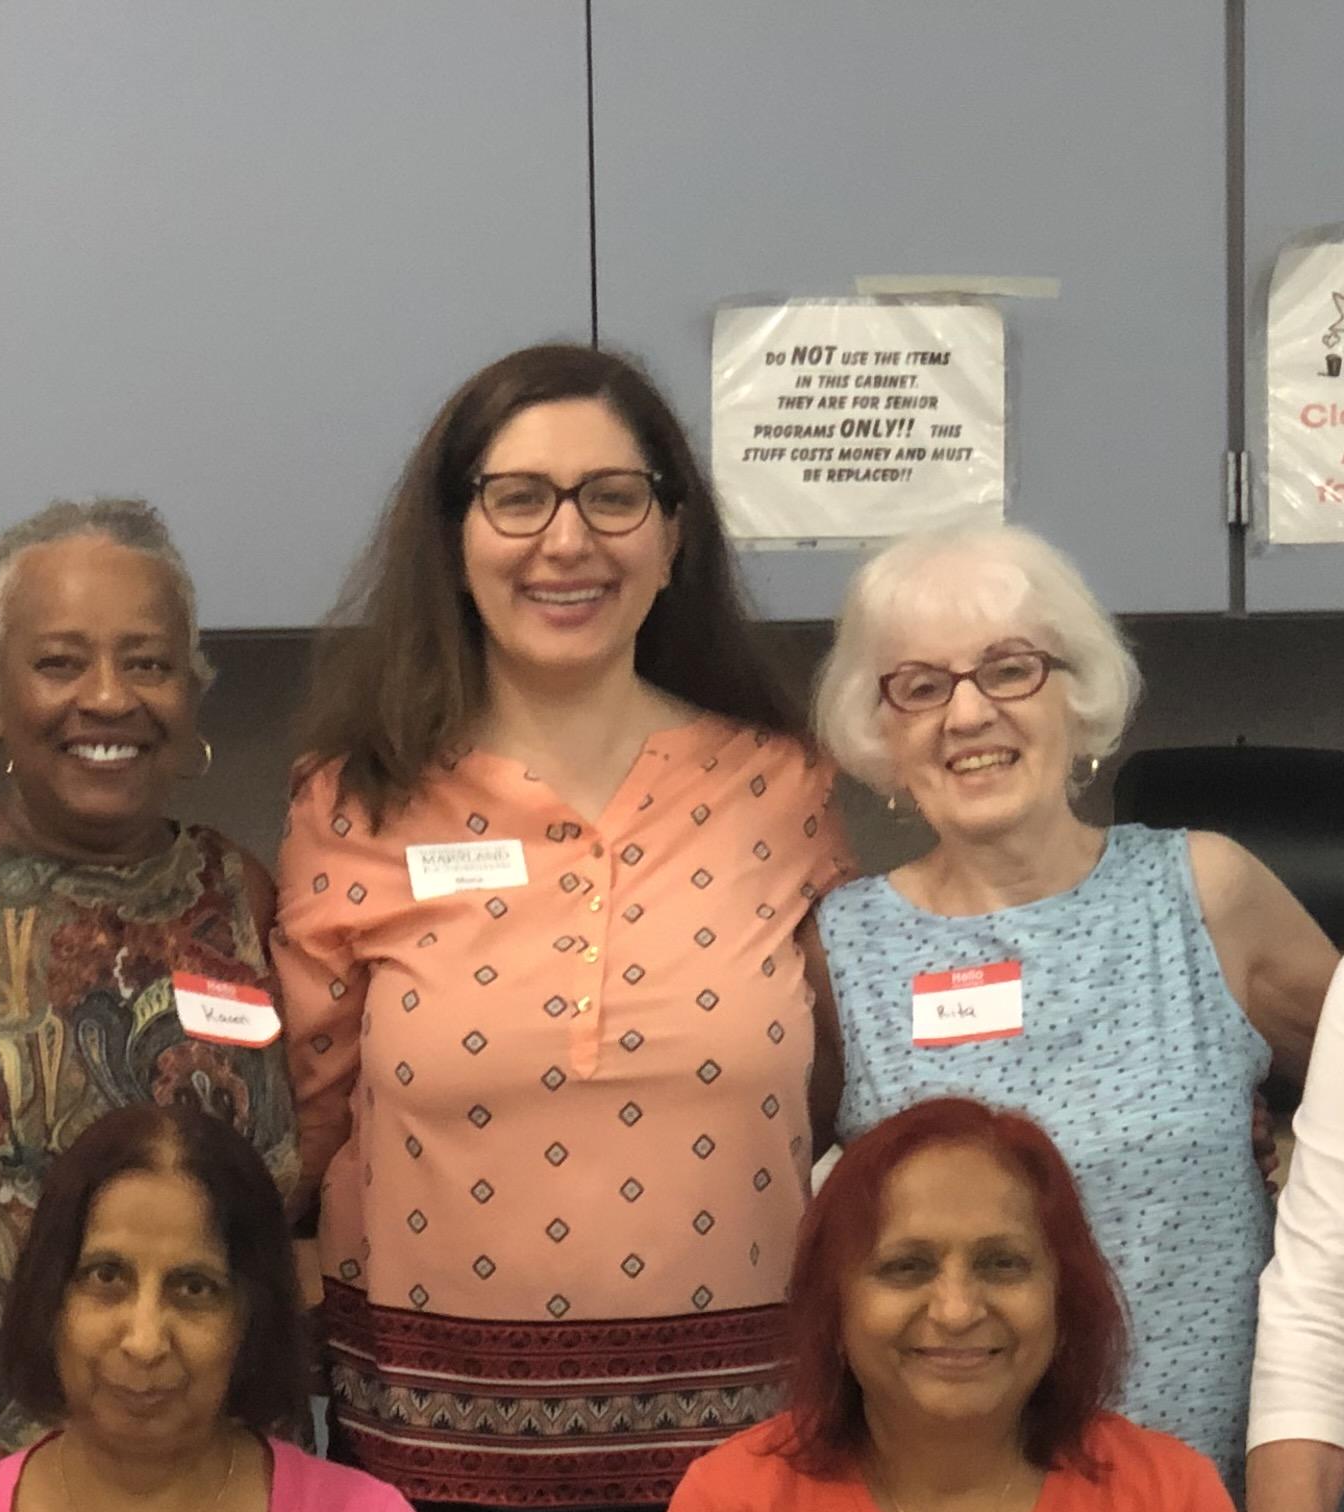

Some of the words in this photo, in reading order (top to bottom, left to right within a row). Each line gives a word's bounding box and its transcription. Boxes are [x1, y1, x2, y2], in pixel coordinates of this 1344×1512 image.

[765, 352, 786, 366] DO
[791, 345, 837, 366] NOT
[840, 351, 868, 366] USE
[874, 351, 901, 365] THE
[905, 351, 951, 366] ITEMS
[795, 375, 812, 388] IN
[817, 375, 849, 389] THIS
[777, 396, 814, 410] THEY
[817, 396, 847, 410] ARE
[852, 395, 880, 409] FOR
[884, 395, 939, 409] SENIOR
[753, 424, 835, 439] PROGRAMS
[840, 418, 915, 438] ONLY!!
[930, 424, 962, 438] THIS
[742, 448, 787, 462] STUFF
[790, 448, 833, 462] COSTS
[838, 447, 892, 461] MONEY
[895, 447, 927, 461] AND
[930, 447, 974, 461] MUST
[802, 468, 821, 482] BE
[826, 468, 913, 482] REPLACED!!
